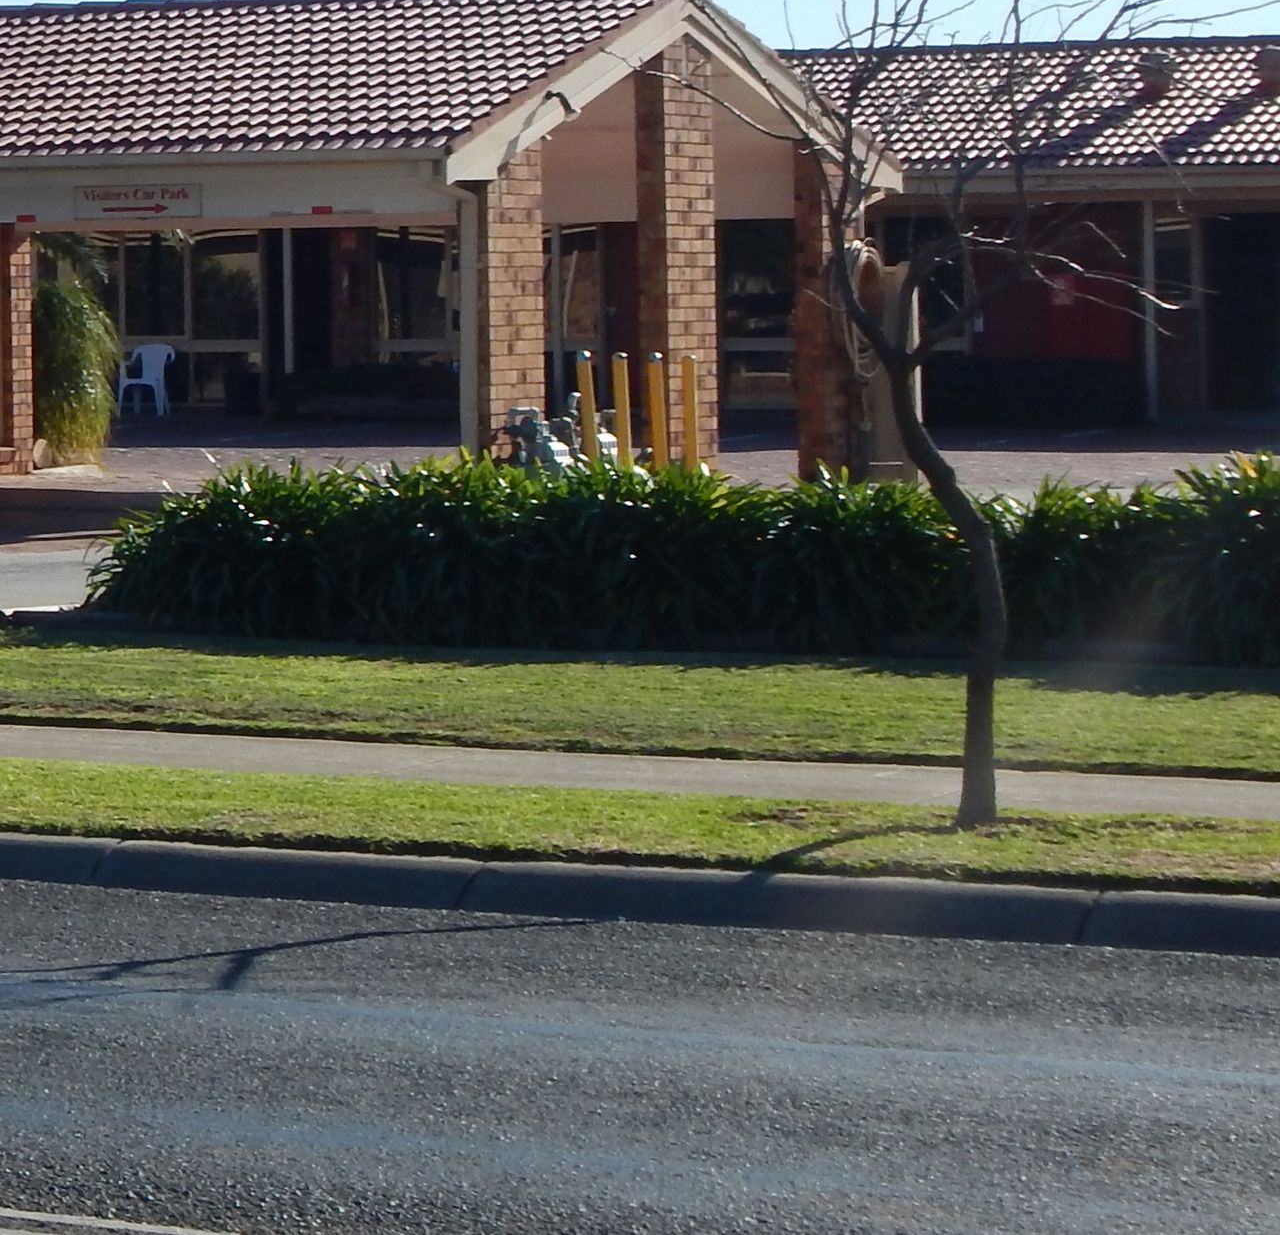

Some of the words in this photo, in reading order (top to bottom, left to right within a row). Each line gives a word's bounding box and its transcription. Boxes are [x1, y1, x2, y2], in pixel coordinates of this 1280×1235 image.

[82, 188, 130, 202] Visitors
[133, 188, 157, 200] Car
[160, 187, 190, 200] Park
